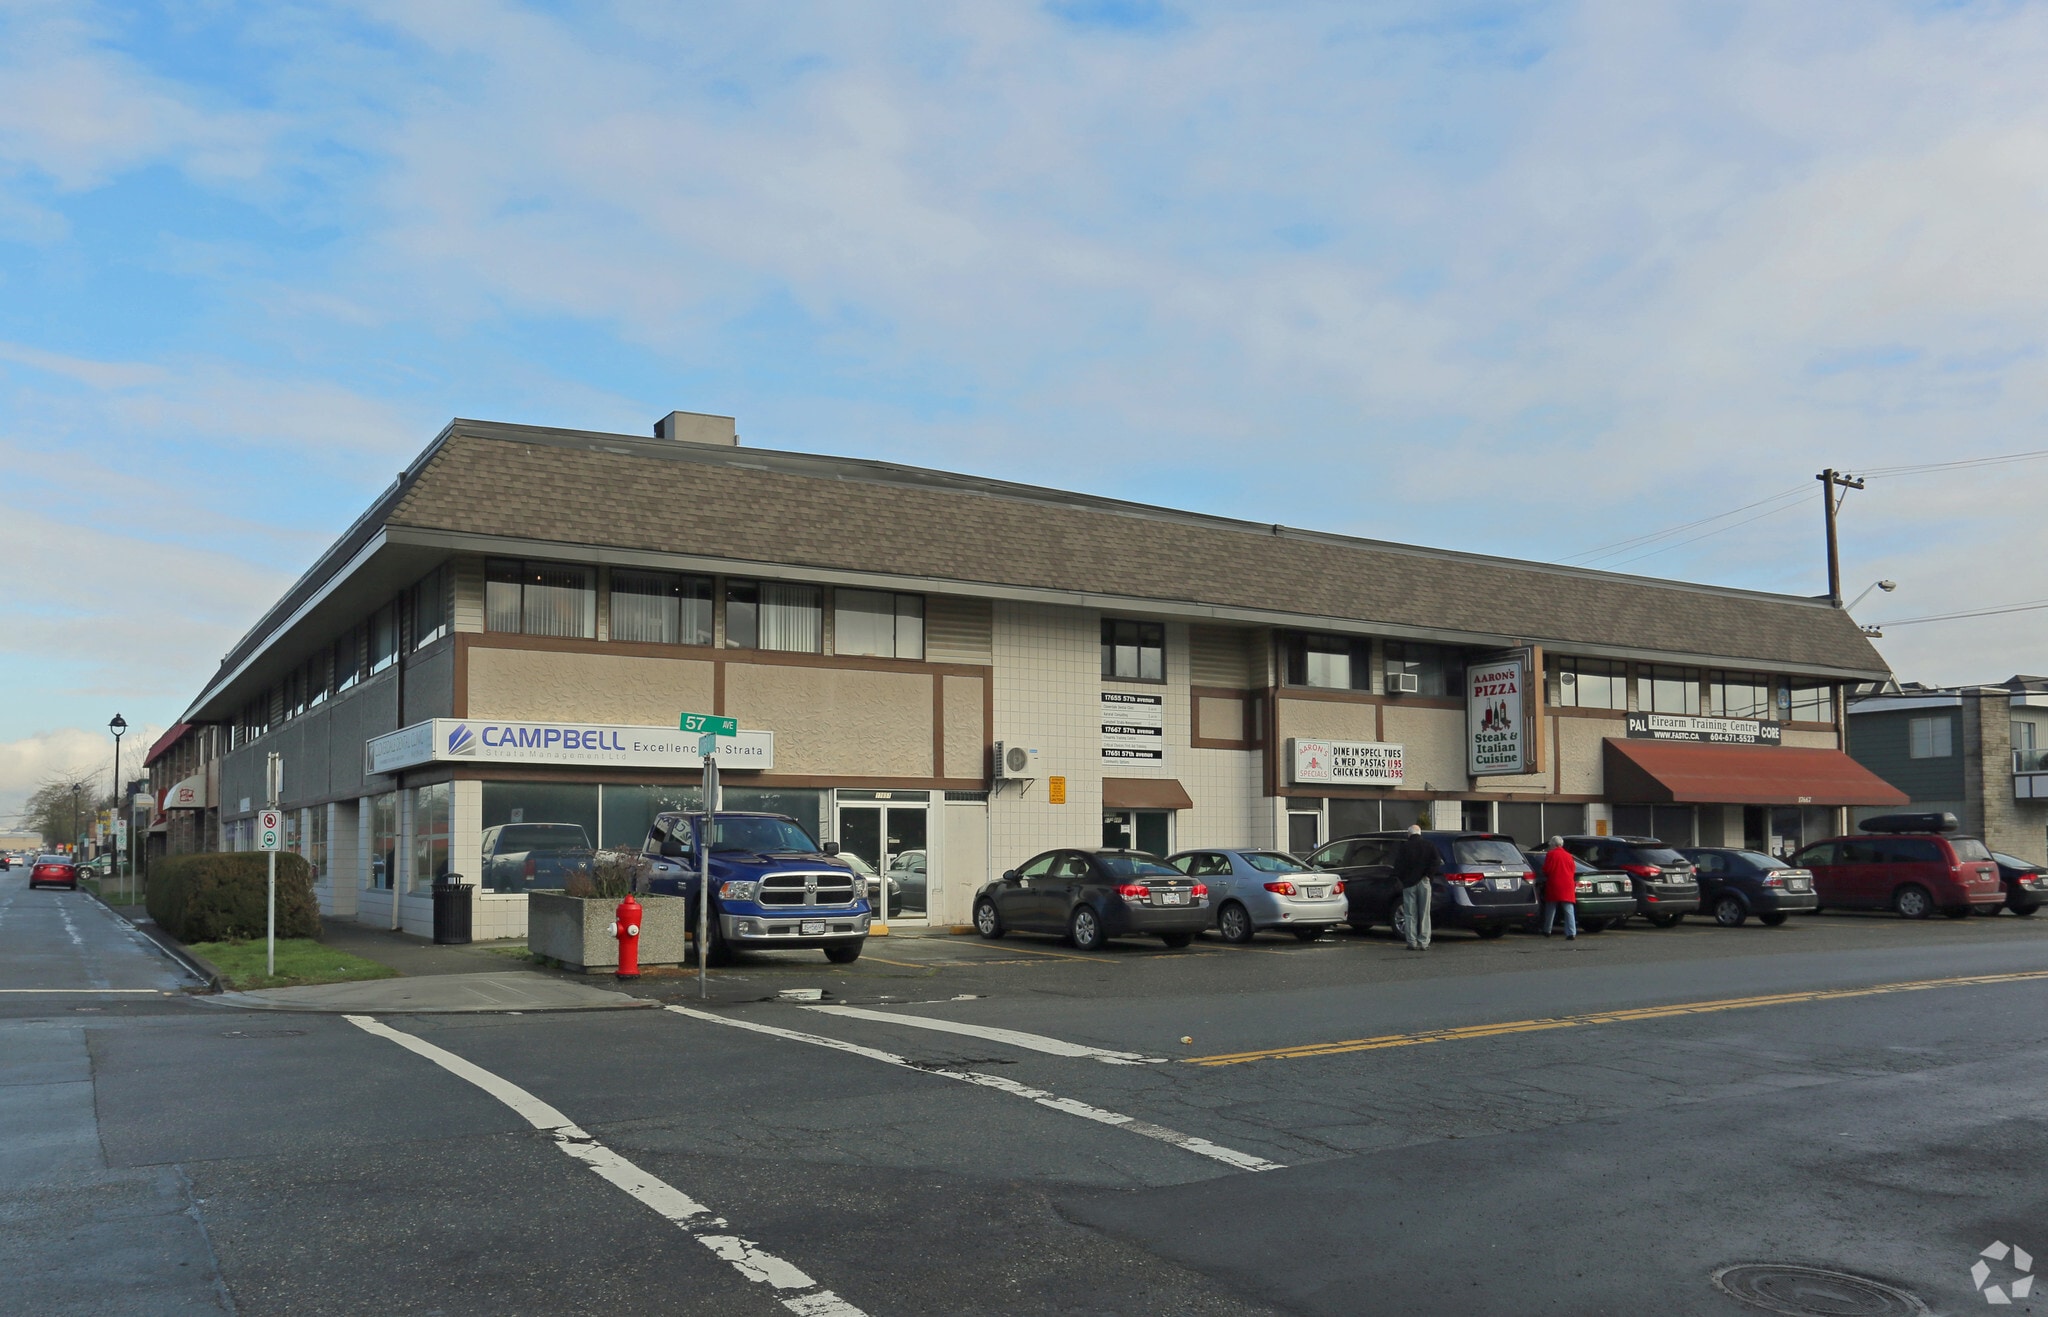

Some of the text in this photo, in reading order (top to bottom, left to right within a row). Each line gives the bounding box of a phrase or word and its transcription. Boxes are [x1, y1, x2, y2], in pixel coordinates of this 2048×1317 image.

[1473, 669, 1515, 684] AARON'S
[1474, 682, 1517, 698] PIZZA
[685, 716, 734, 731] 57 AVE
[1629, 715, 1780, 739] PAL Firearm Training Centre CORE
[481, 726, 626, 751] CAMPBELL
[1474, 731, 1518, 744] Steak &
[1710, 733, 1756, 743] 604-671-5523
[633, 741, 698, 754] Excellenc
[725, 744, 763, 756] Strata
[1299, 744, 1329, 757] AARON'S
[1333, 747, 1402, 758] DINE IN SPECL TUES
[1476, 742, 1516, 754] Italian
[485, 749, 627, 761] Strata Management Ltd
[1475, 753, 1518, 765] Cuisine
[1334, 757, 1339, 766] &
[1341, 758, 1356, 767] WED
[1360, 758, 1386, 768] PASTAS
[1299, 769, 1328, 778] SPECIALS
[1332, 767, 1363, 777] CHICKEN
